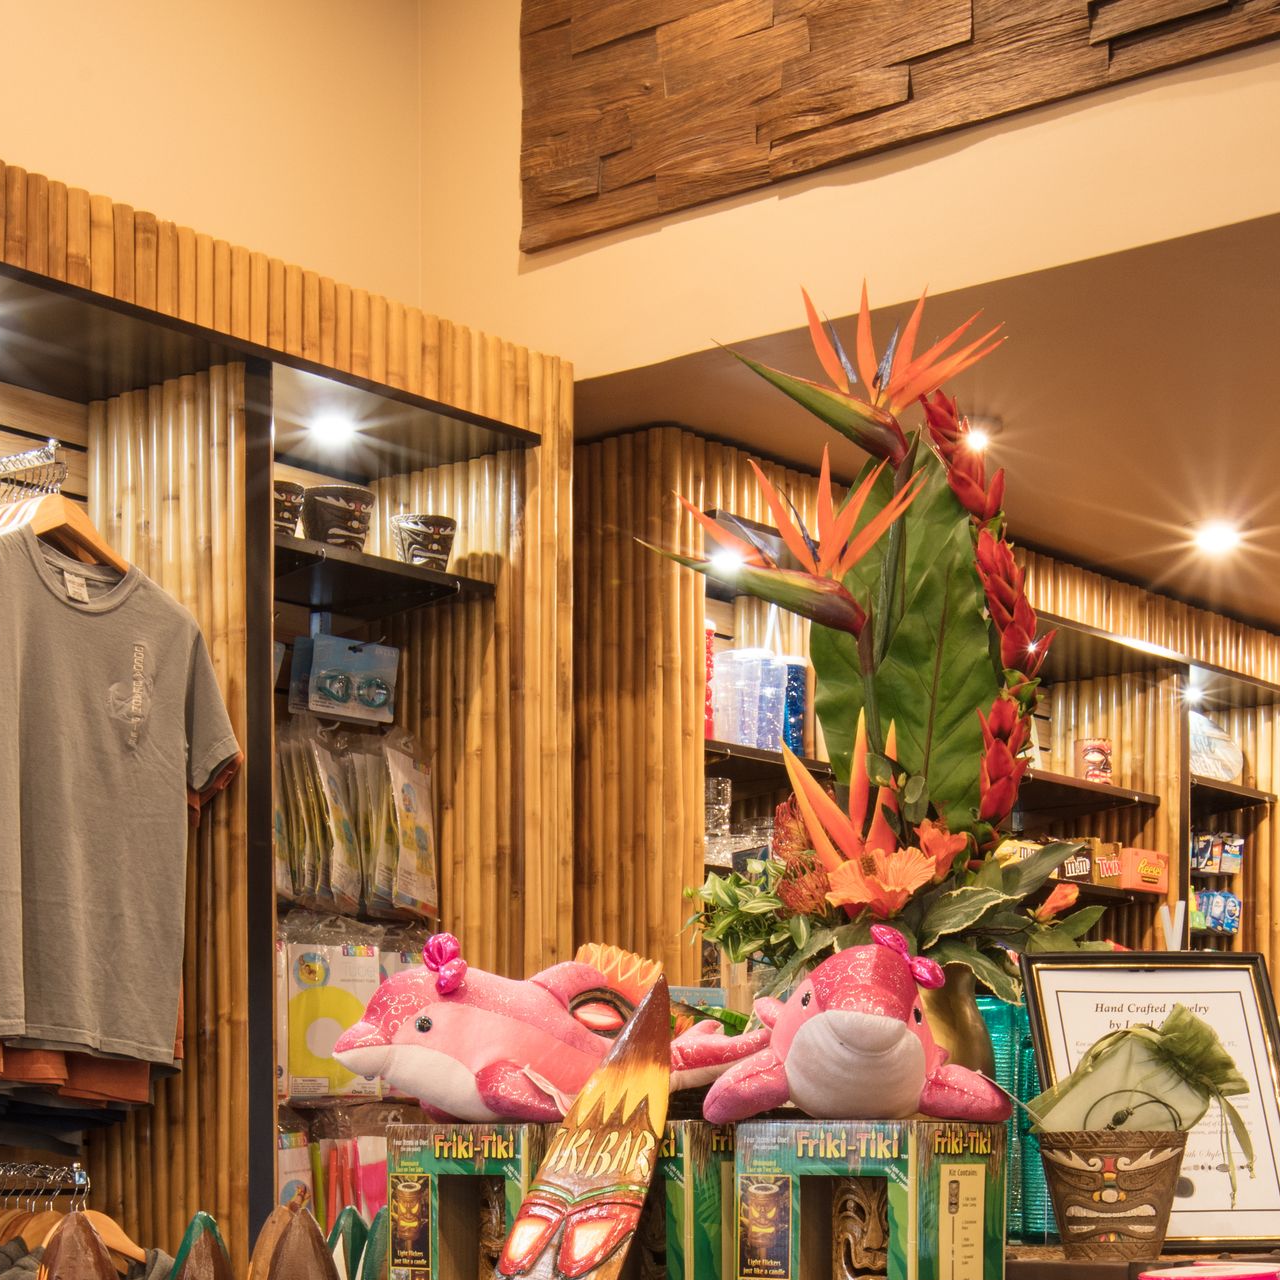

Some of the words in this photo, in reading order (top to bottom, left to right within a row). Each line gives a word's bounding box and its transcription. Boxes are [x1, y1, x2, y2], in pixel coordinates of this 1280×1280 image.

[342, 945, 375, 957] INTEX
[1095, 1002, 1124, 1013] Hand
[1127, 1002, 1166, 1016] Crafted
[434, 1130, 515, 1160] Friki-Tiki
[584, 1130, 656, 1178] BAR
[795, 1127, 900, 1160] Friki-Tiki
[933, 1128, 992, 1155] Friki-Tiki
